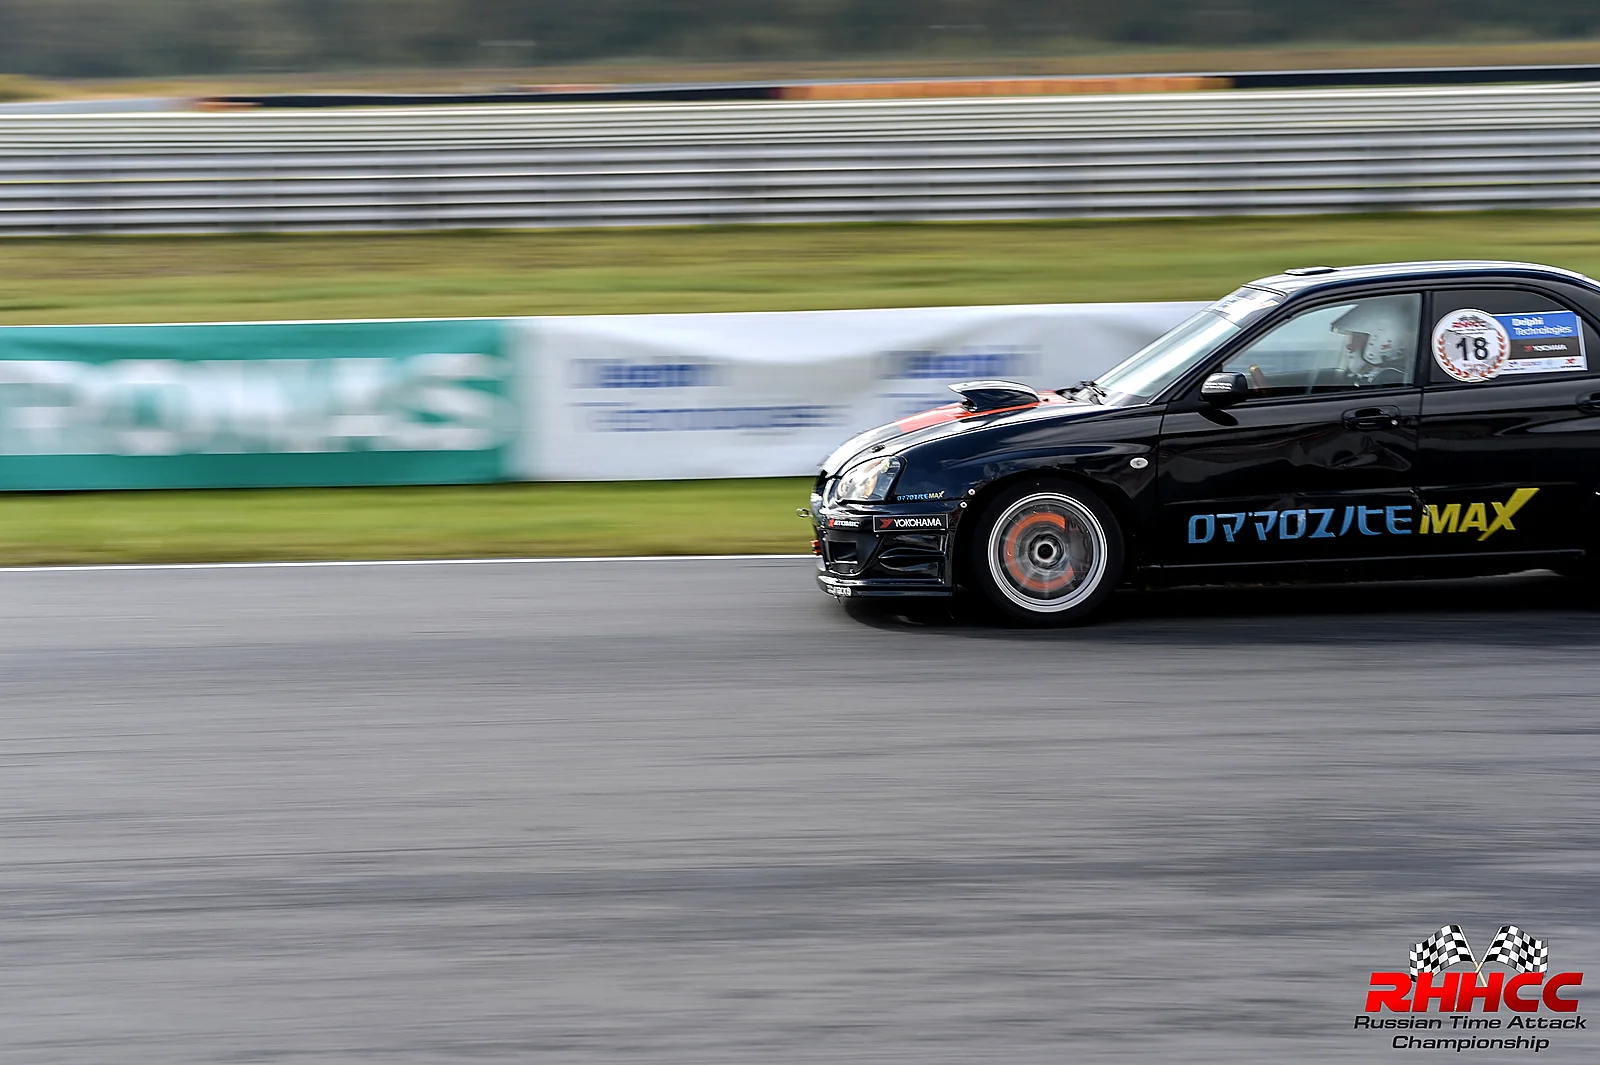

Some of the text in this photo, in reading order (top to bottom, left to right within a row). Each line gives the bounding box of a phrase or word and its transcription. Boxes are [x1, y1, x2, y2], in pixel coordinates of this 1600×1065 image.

[1511, 317, 1544, 327] Delphi
[1456, 337, 1489, 361] 18
[893, 517, 943, 528] YOKOHAMA
[1418, 487, 1540, 541] MAX
